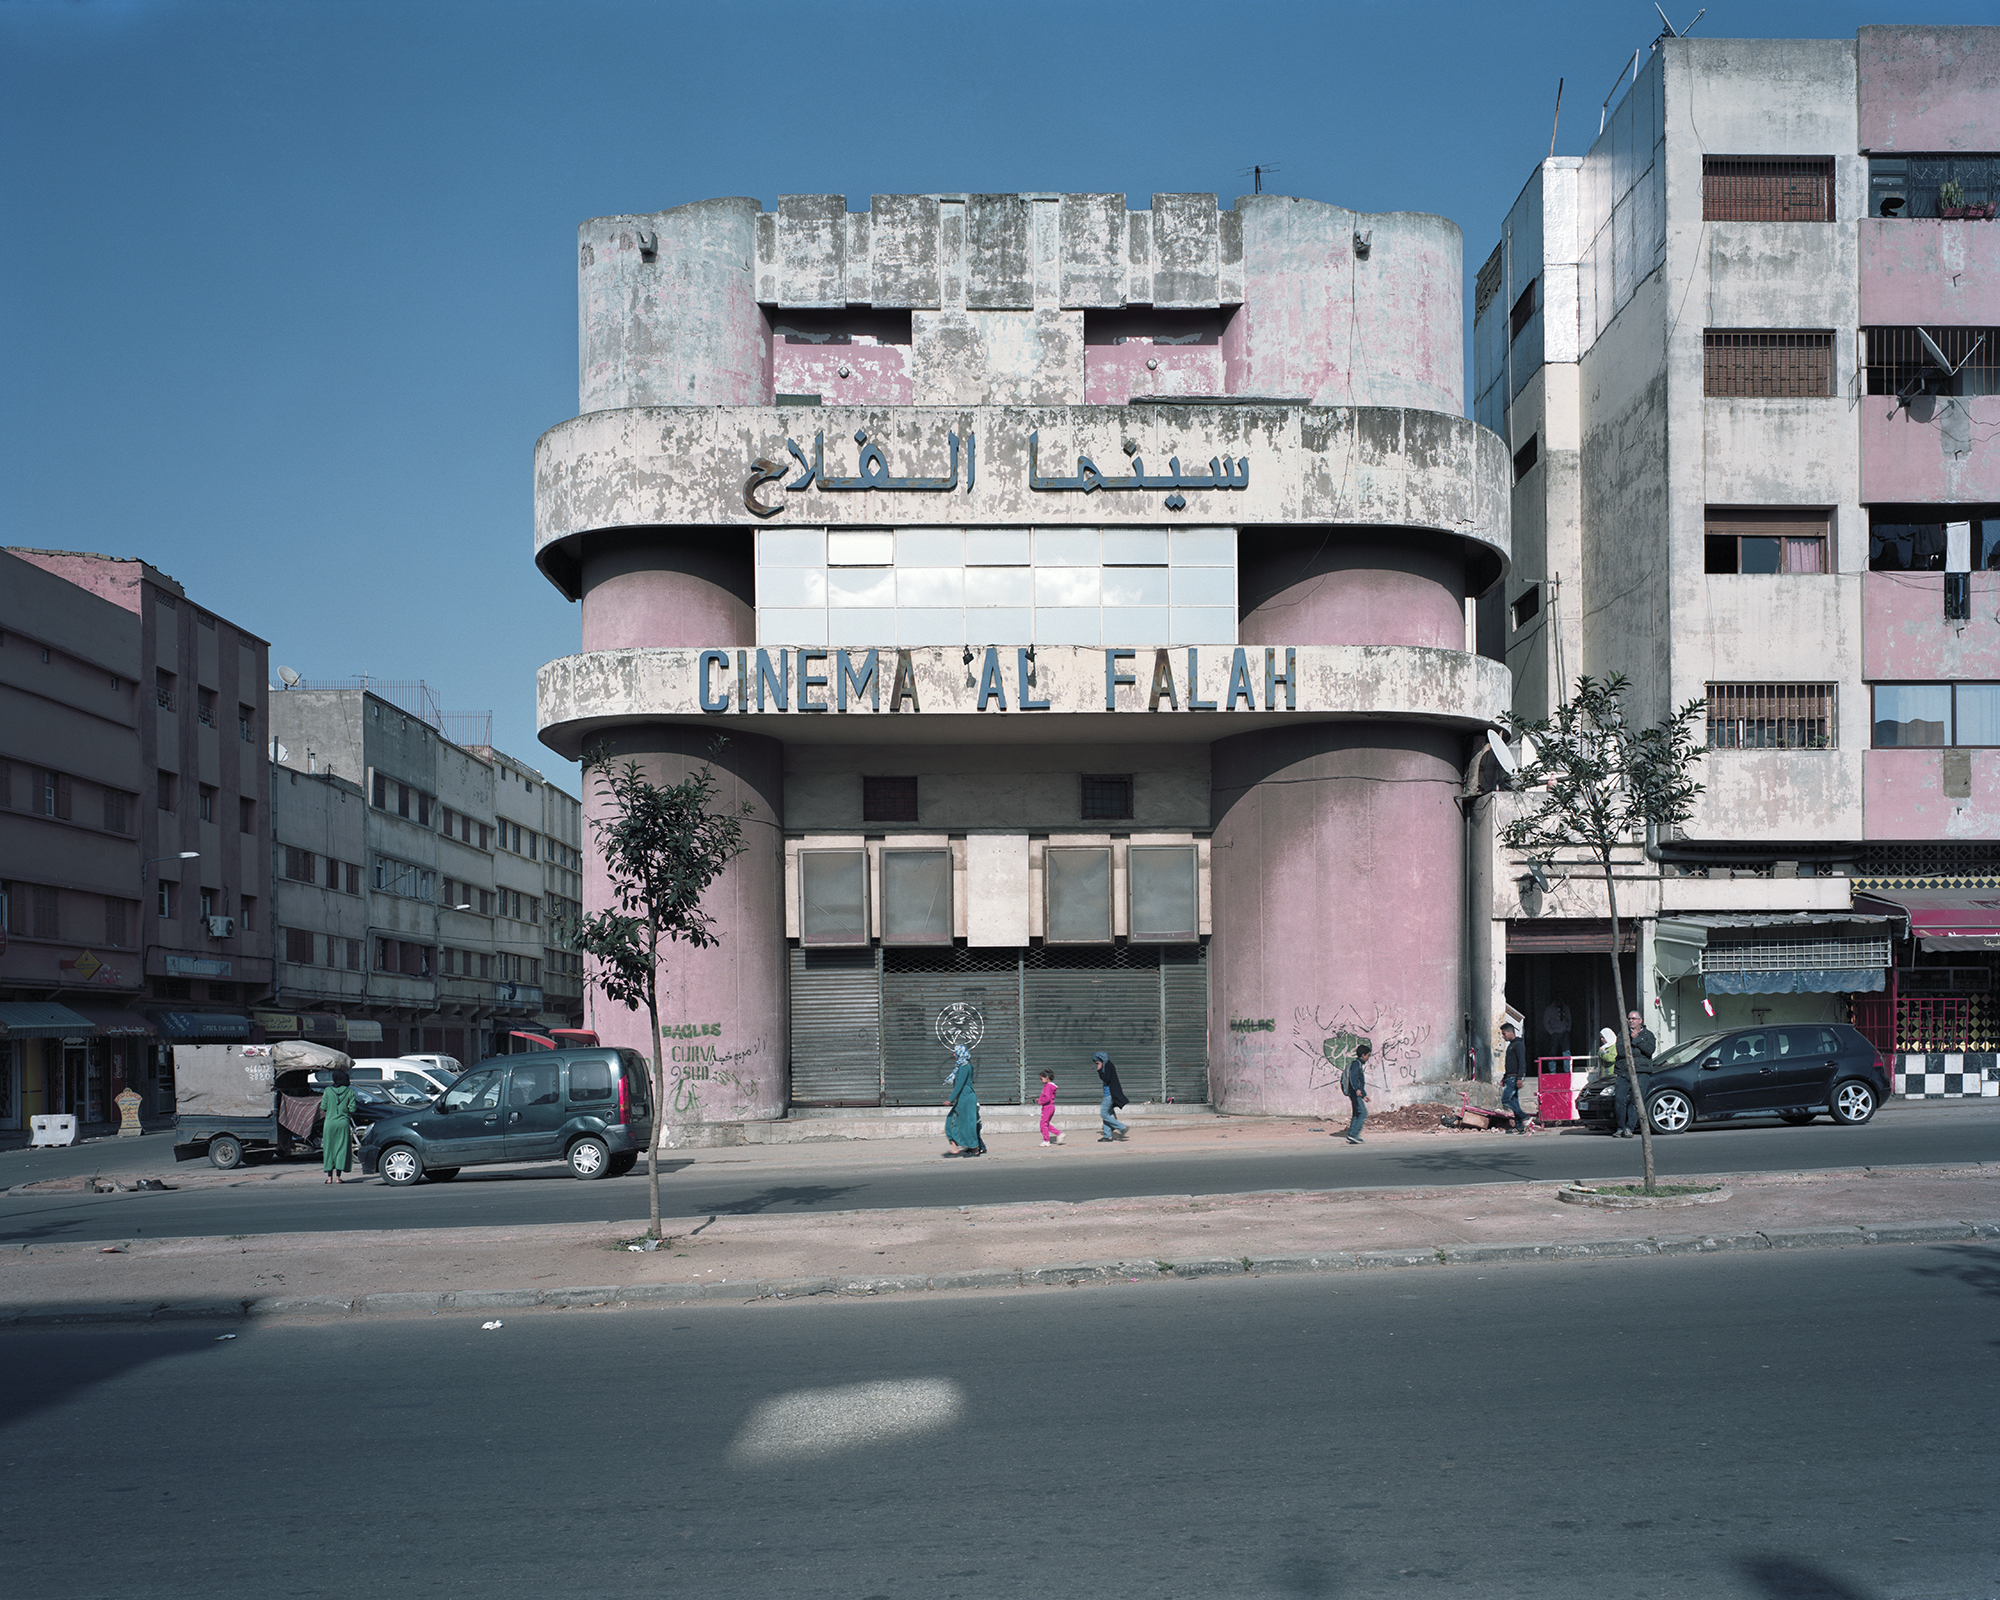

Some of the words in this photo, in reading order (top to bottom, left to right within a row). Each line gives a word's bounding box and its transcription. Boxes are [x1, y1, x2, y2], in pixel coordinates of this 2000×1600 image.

[742, 430, 977, 517] الفلاح
[1029, 431, 1250, 511] سينما
[699, 647, 921, 714] CINEMA
[977, 648, 1051, 711] AL
[1105, 646, 1296, 714] FALAH
[661, 1022, 722, 1040] EAGLES
[671, 1045, 716, 1063] CURVA
